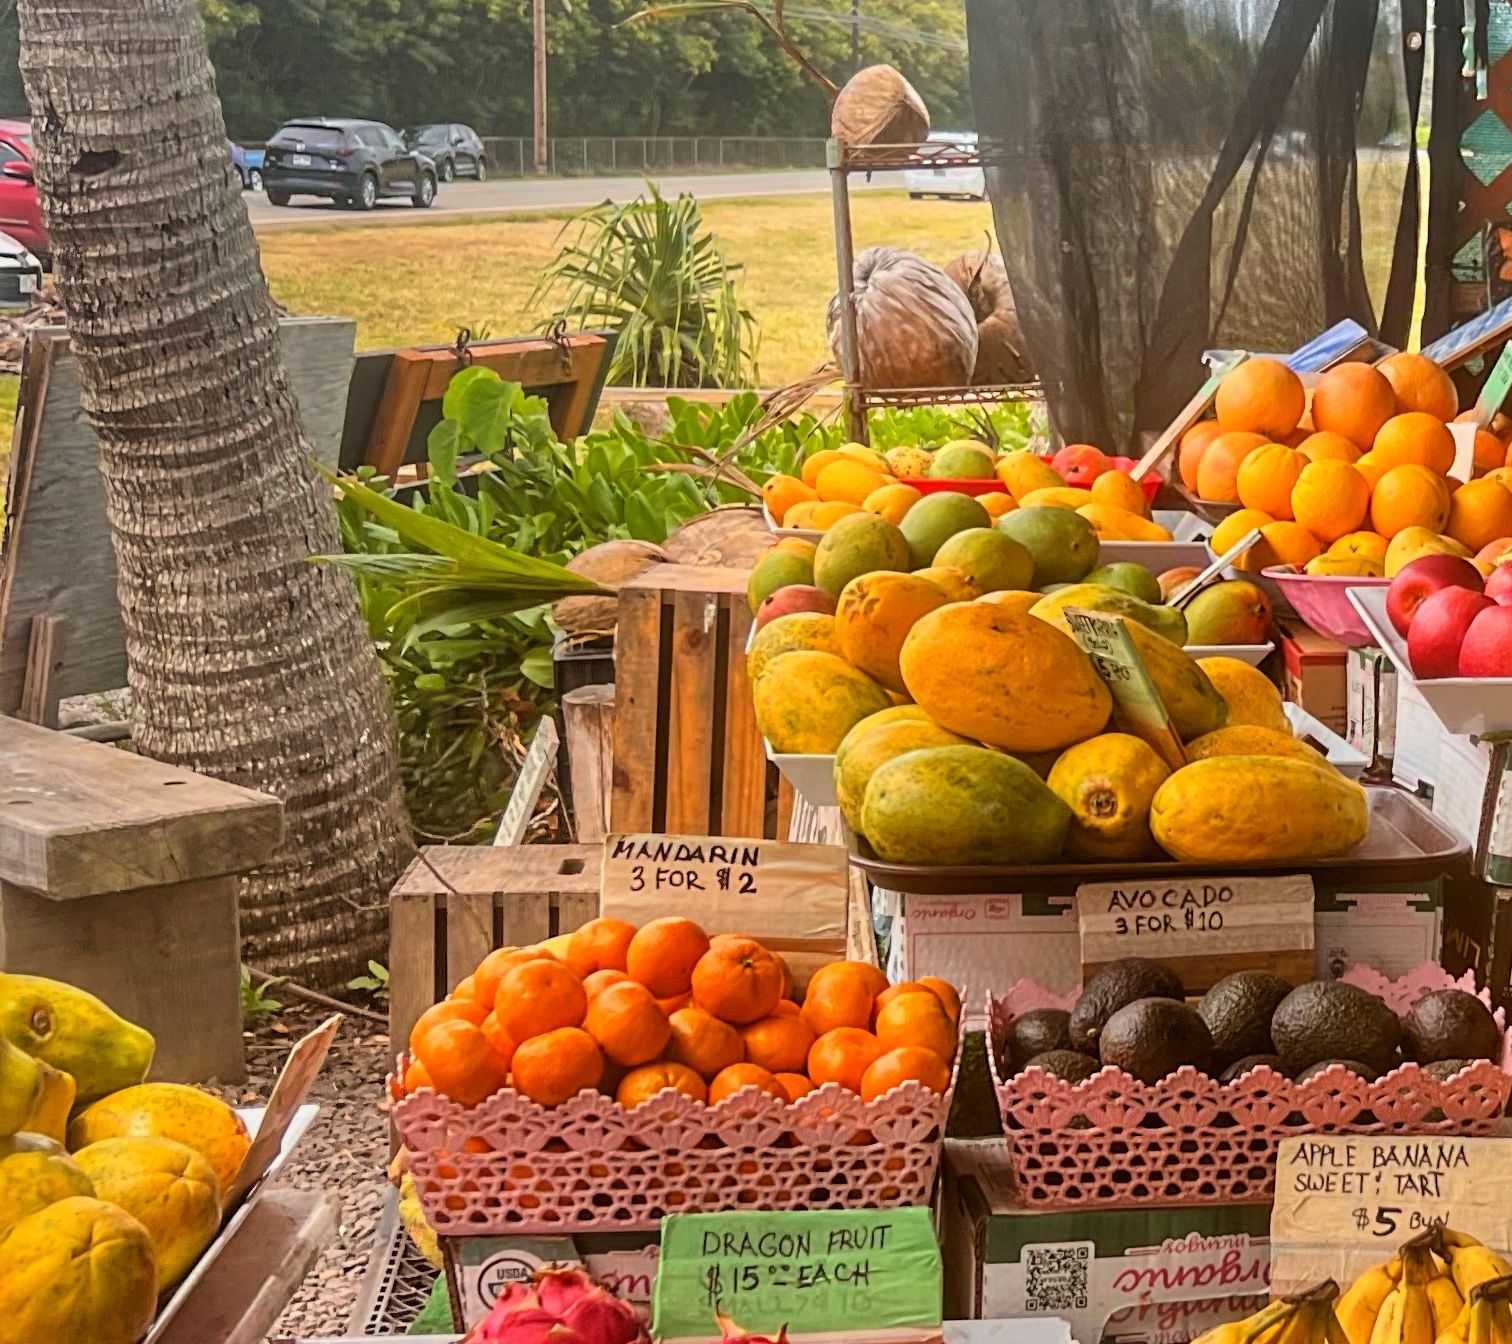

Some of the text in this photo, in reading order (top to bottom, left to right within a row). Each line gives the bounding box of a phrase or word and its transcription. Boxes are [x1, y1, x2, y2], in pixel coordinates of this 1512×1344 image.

[612, 837, 760, 867] MANDARIN
[630, 865, 645, 891] 3
[655, 868, 705, 891] FOR
[911, 903, 976, 921] Organic
[1108, 885, 1233, 912] AVOCADO
[1115, 908, 1224, 936] 3 FOR $10
[1289, 1143, 1470, 1169] APPLE BANANA
[1294, 1171, 1371, 1195] SWEET
[1393, 1170, 1446, 1197] TART
[1352, 1206, 1403, 1237] $5
[702, 1223, 893, 1258] DRAGON FRUIT
[496, 1267, 528, 1281] USDA
[796, 1259, 874, 1289] EACH
